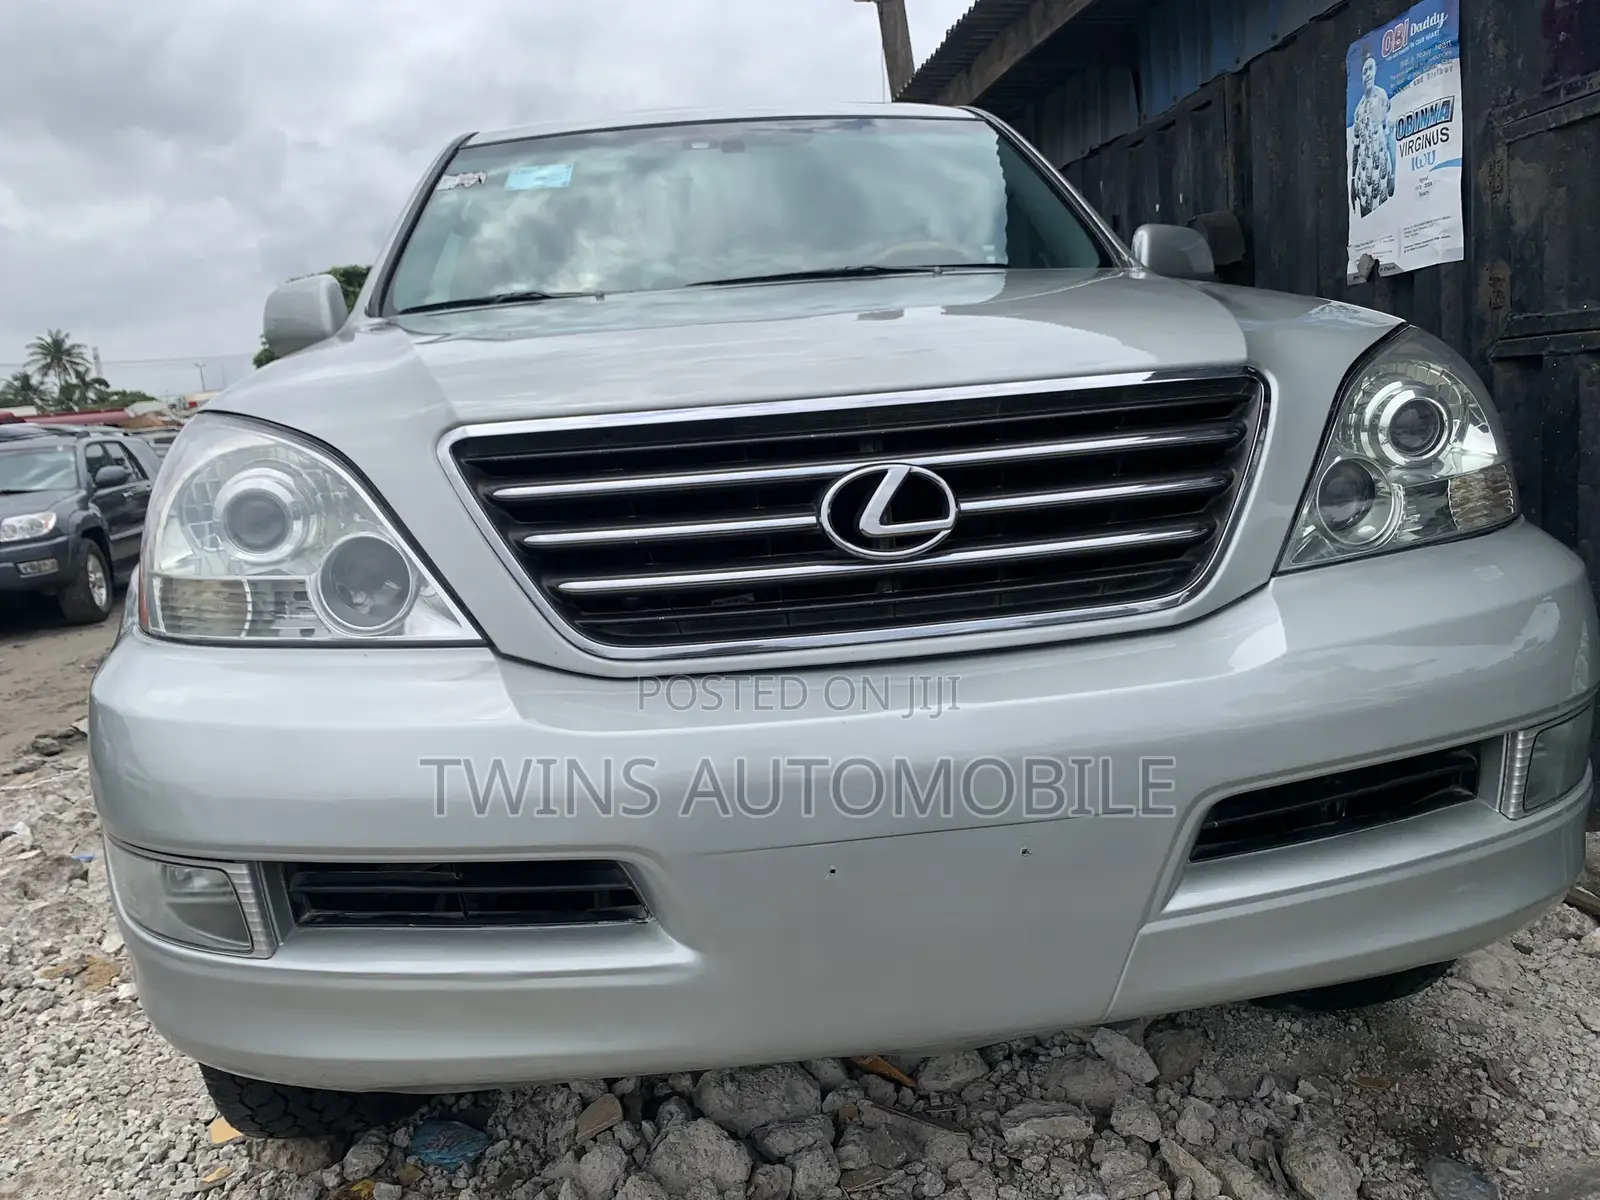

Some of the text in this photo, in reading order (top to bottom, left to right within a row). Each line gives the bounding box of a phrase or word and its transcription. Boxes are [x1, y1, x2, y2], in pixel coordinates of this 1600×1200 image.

[1381, 18, 1410, 58] OBI
[1410, 11, 1448, 37] Daddy
[1396, 97, 1454, 141] OBINNA
[1399, 126, 1450, 158] VIRGINUS
